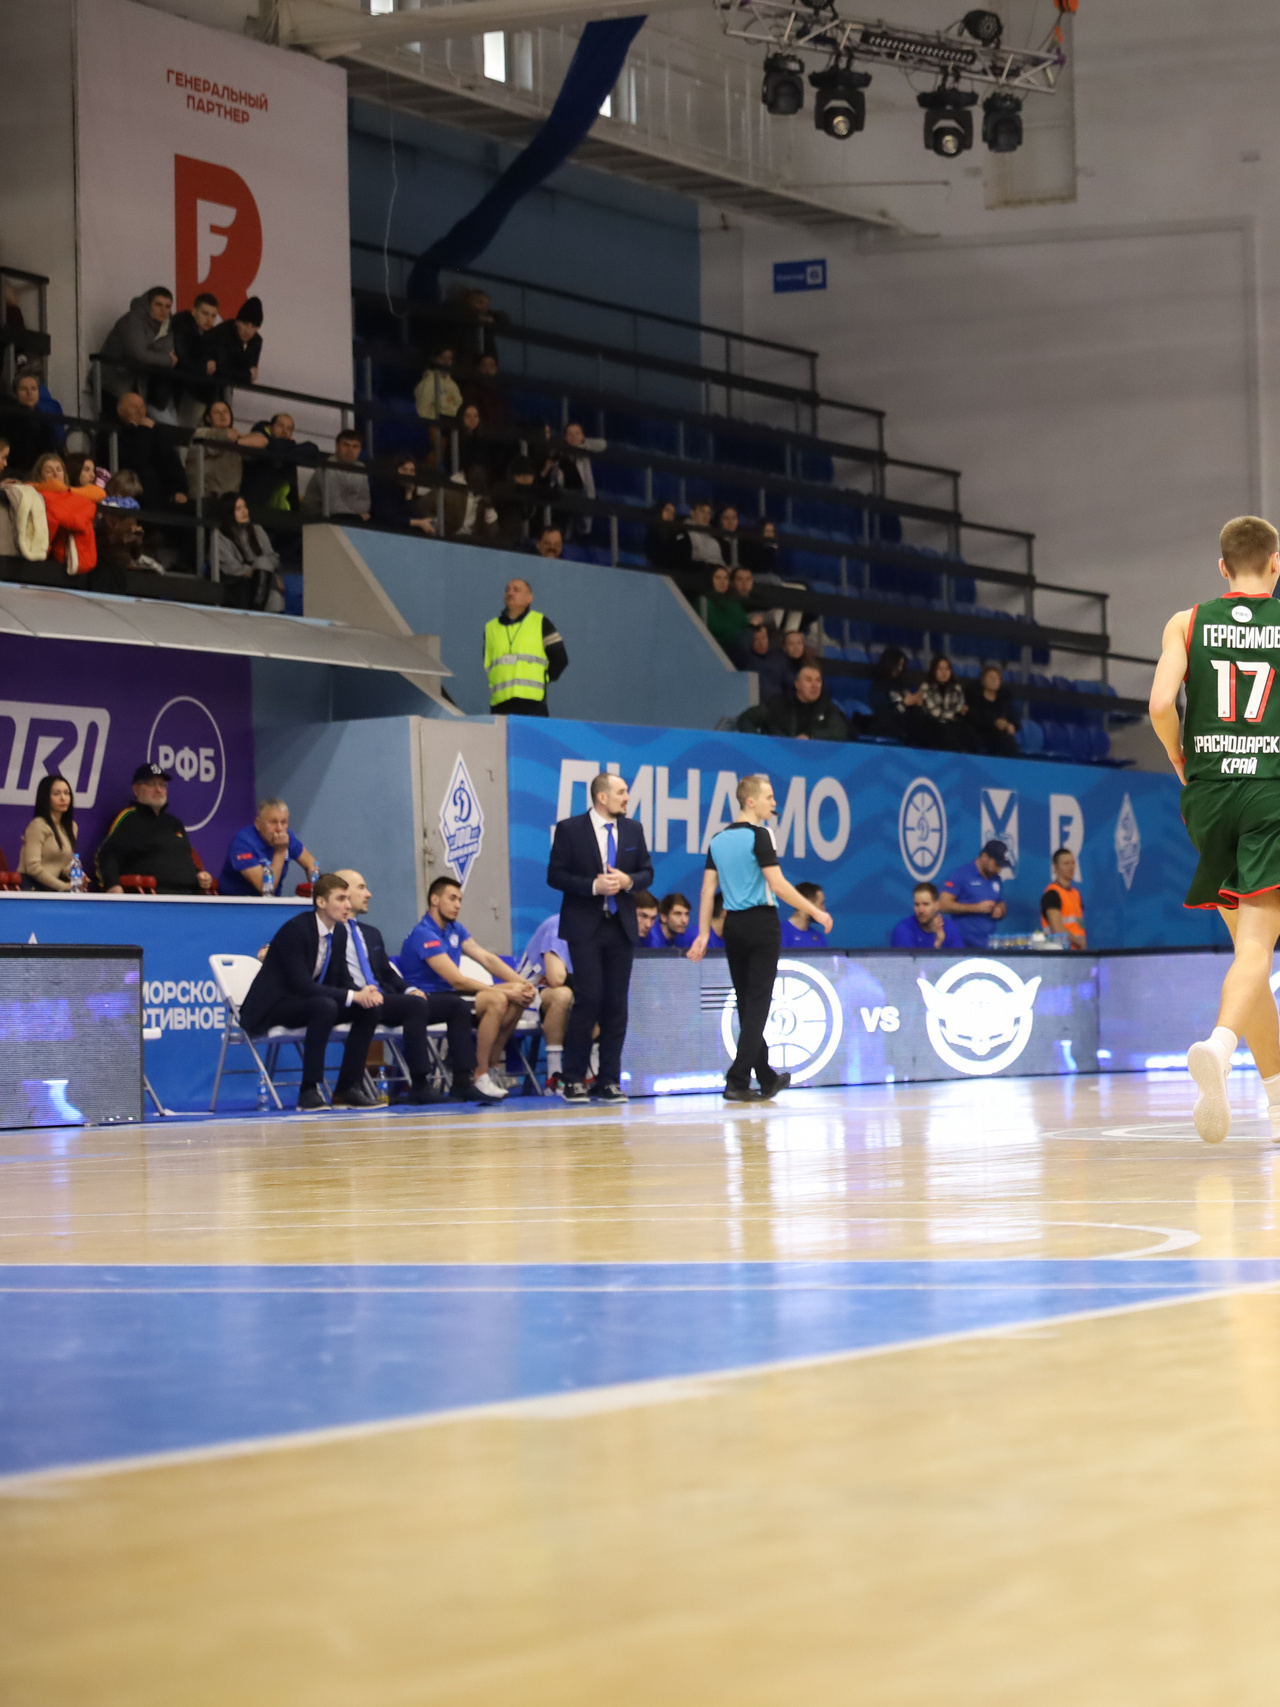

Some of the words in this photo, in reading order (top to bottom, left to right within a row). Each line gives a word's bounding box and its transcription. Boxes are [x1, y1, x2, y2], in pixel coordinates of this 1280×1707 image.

[167, 69, 269, 112] ГЕНЕРАЛЬНЫЙ
[187, 94, 250, 124] ПАРТНЕР
[1210, 660, 1276, 722] 17
[158, 745, 216, 782] РФБ
[1221, 757, 1258, 775] КРАЙ
